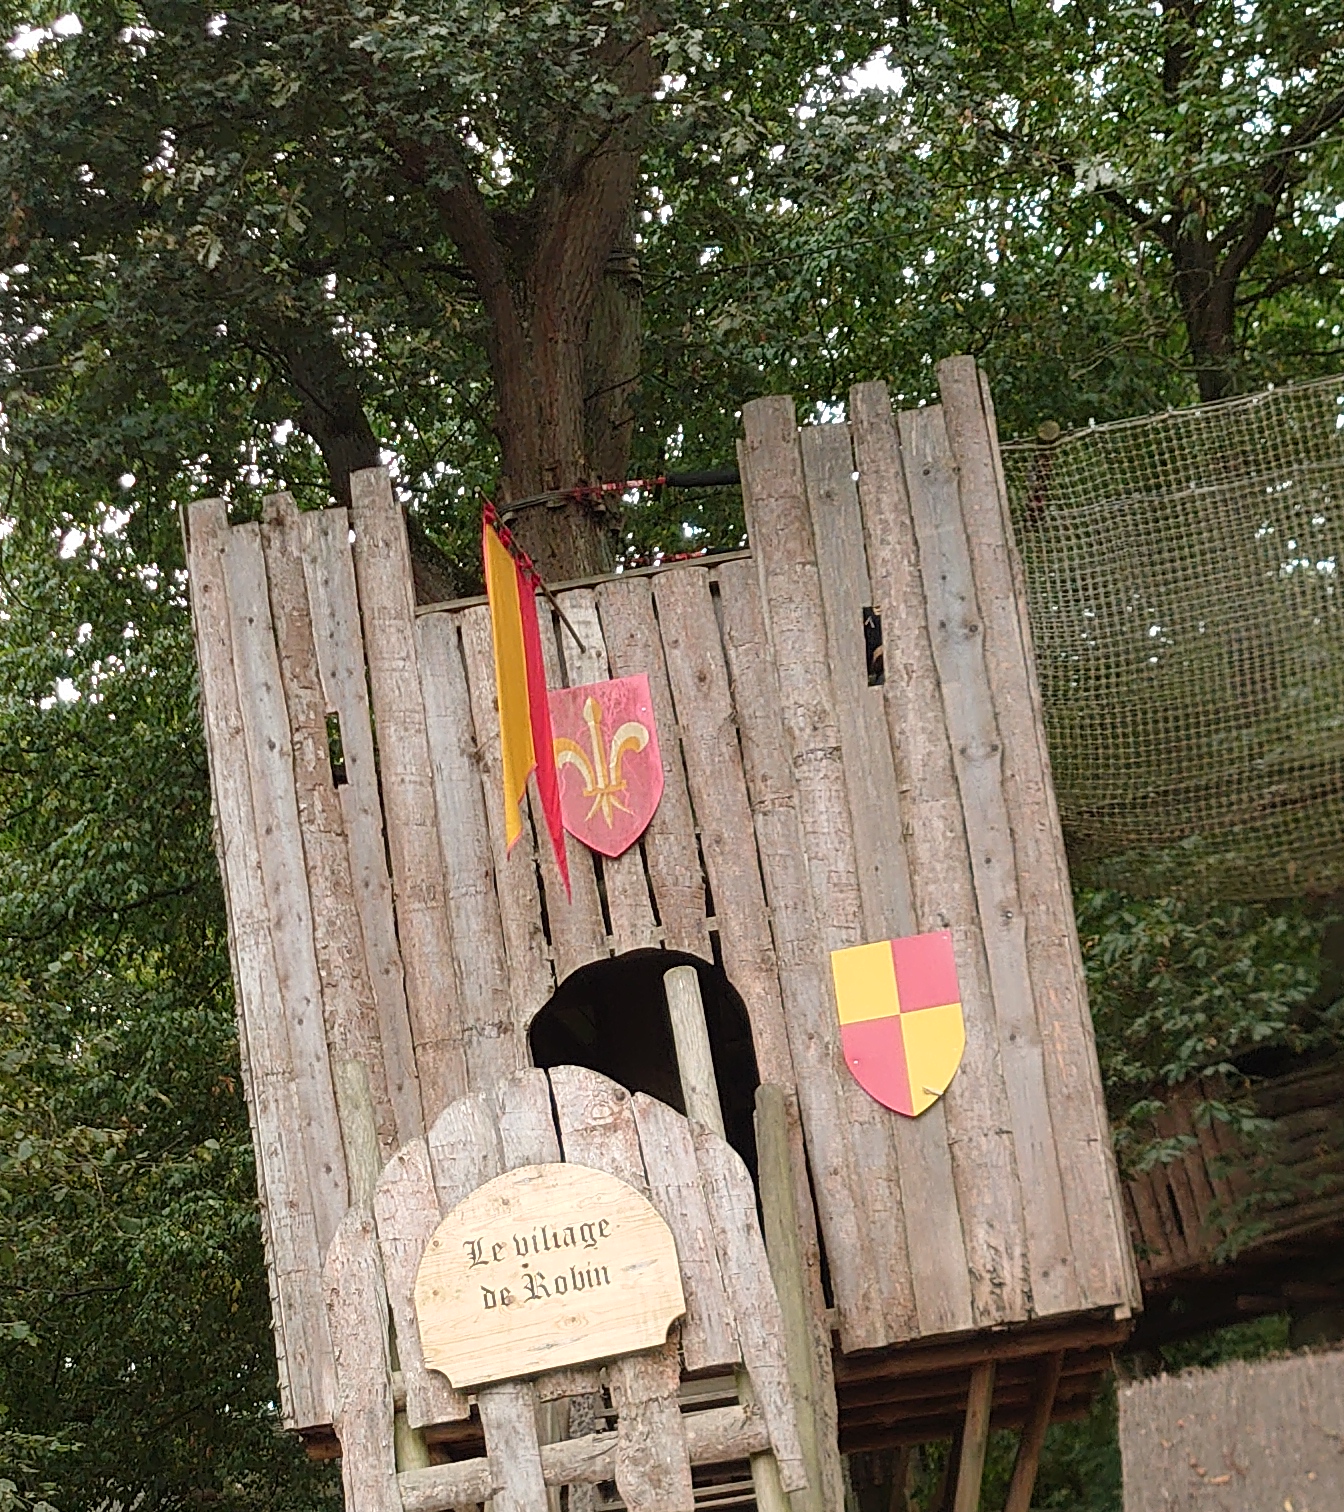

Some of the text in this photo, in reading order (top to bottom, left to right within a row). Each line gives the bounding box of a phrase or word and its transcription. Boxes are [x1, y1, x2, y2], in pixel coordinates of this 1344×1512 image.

[463, 1237, 505, 1269] Le
[480, 1262, 610, 1309] de Robin
